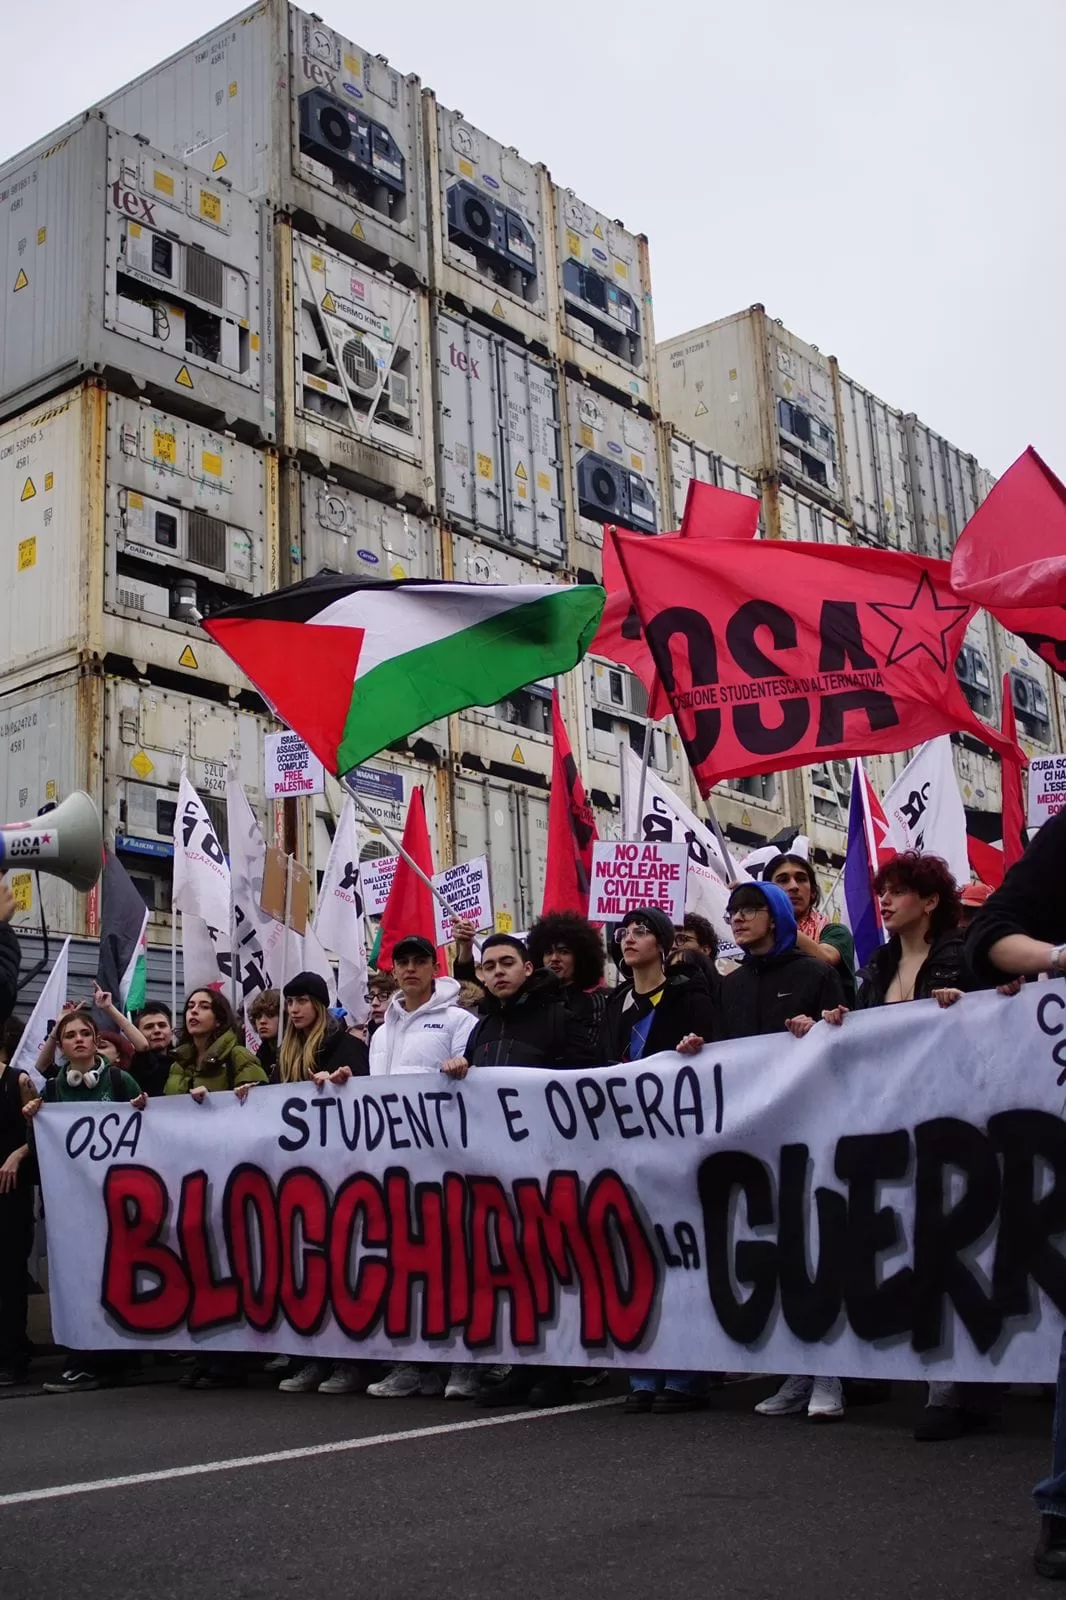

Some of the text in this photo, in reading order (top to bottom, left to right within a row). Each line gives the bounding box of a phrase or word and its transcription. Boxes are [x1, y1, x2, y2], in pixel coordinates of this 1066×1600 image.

[302, 55, 337, 94] tex
[111, 179, 157, 226] tex
[333, 300, 382, 330] THERMO KING
[449, 341, 480, 381] tex
[276, 751, 310, 763] OCCIDENTE
[204, 764, 224, 778] SZLU
[277, 760, 309, 772] COMPLICE
[1031, 760, 1054, 771] CUBA
[284, 769, 303, 782] FREE
[1044, 771, 1053, 781] CI
[204, 777, 226, 792] 96247
[274, 778, 314, 793] PALESTINE
[383, 810, 401, 821] KING
[11, 836, 40, 856] OSA
[614, 844, 662, 862] NO AL
[445, 863, 470, 881] CONTRO
[466, 870, 483, 884] CRISI
[595, 862, 680, 881] NUCLEARE
[363, 877, 374, 885] DAI
[471, 883, 481, 895] ED
[604, 880, 669, 898] CIVILE E
[278, 1063, 724, 1151] STUDENTI E OPERAI
[65, 1111, 143, 1161] OSA
[101, 1162, 660, 1353] BLOCCHIAMO
[654, 1220, 701, 1271] LA
